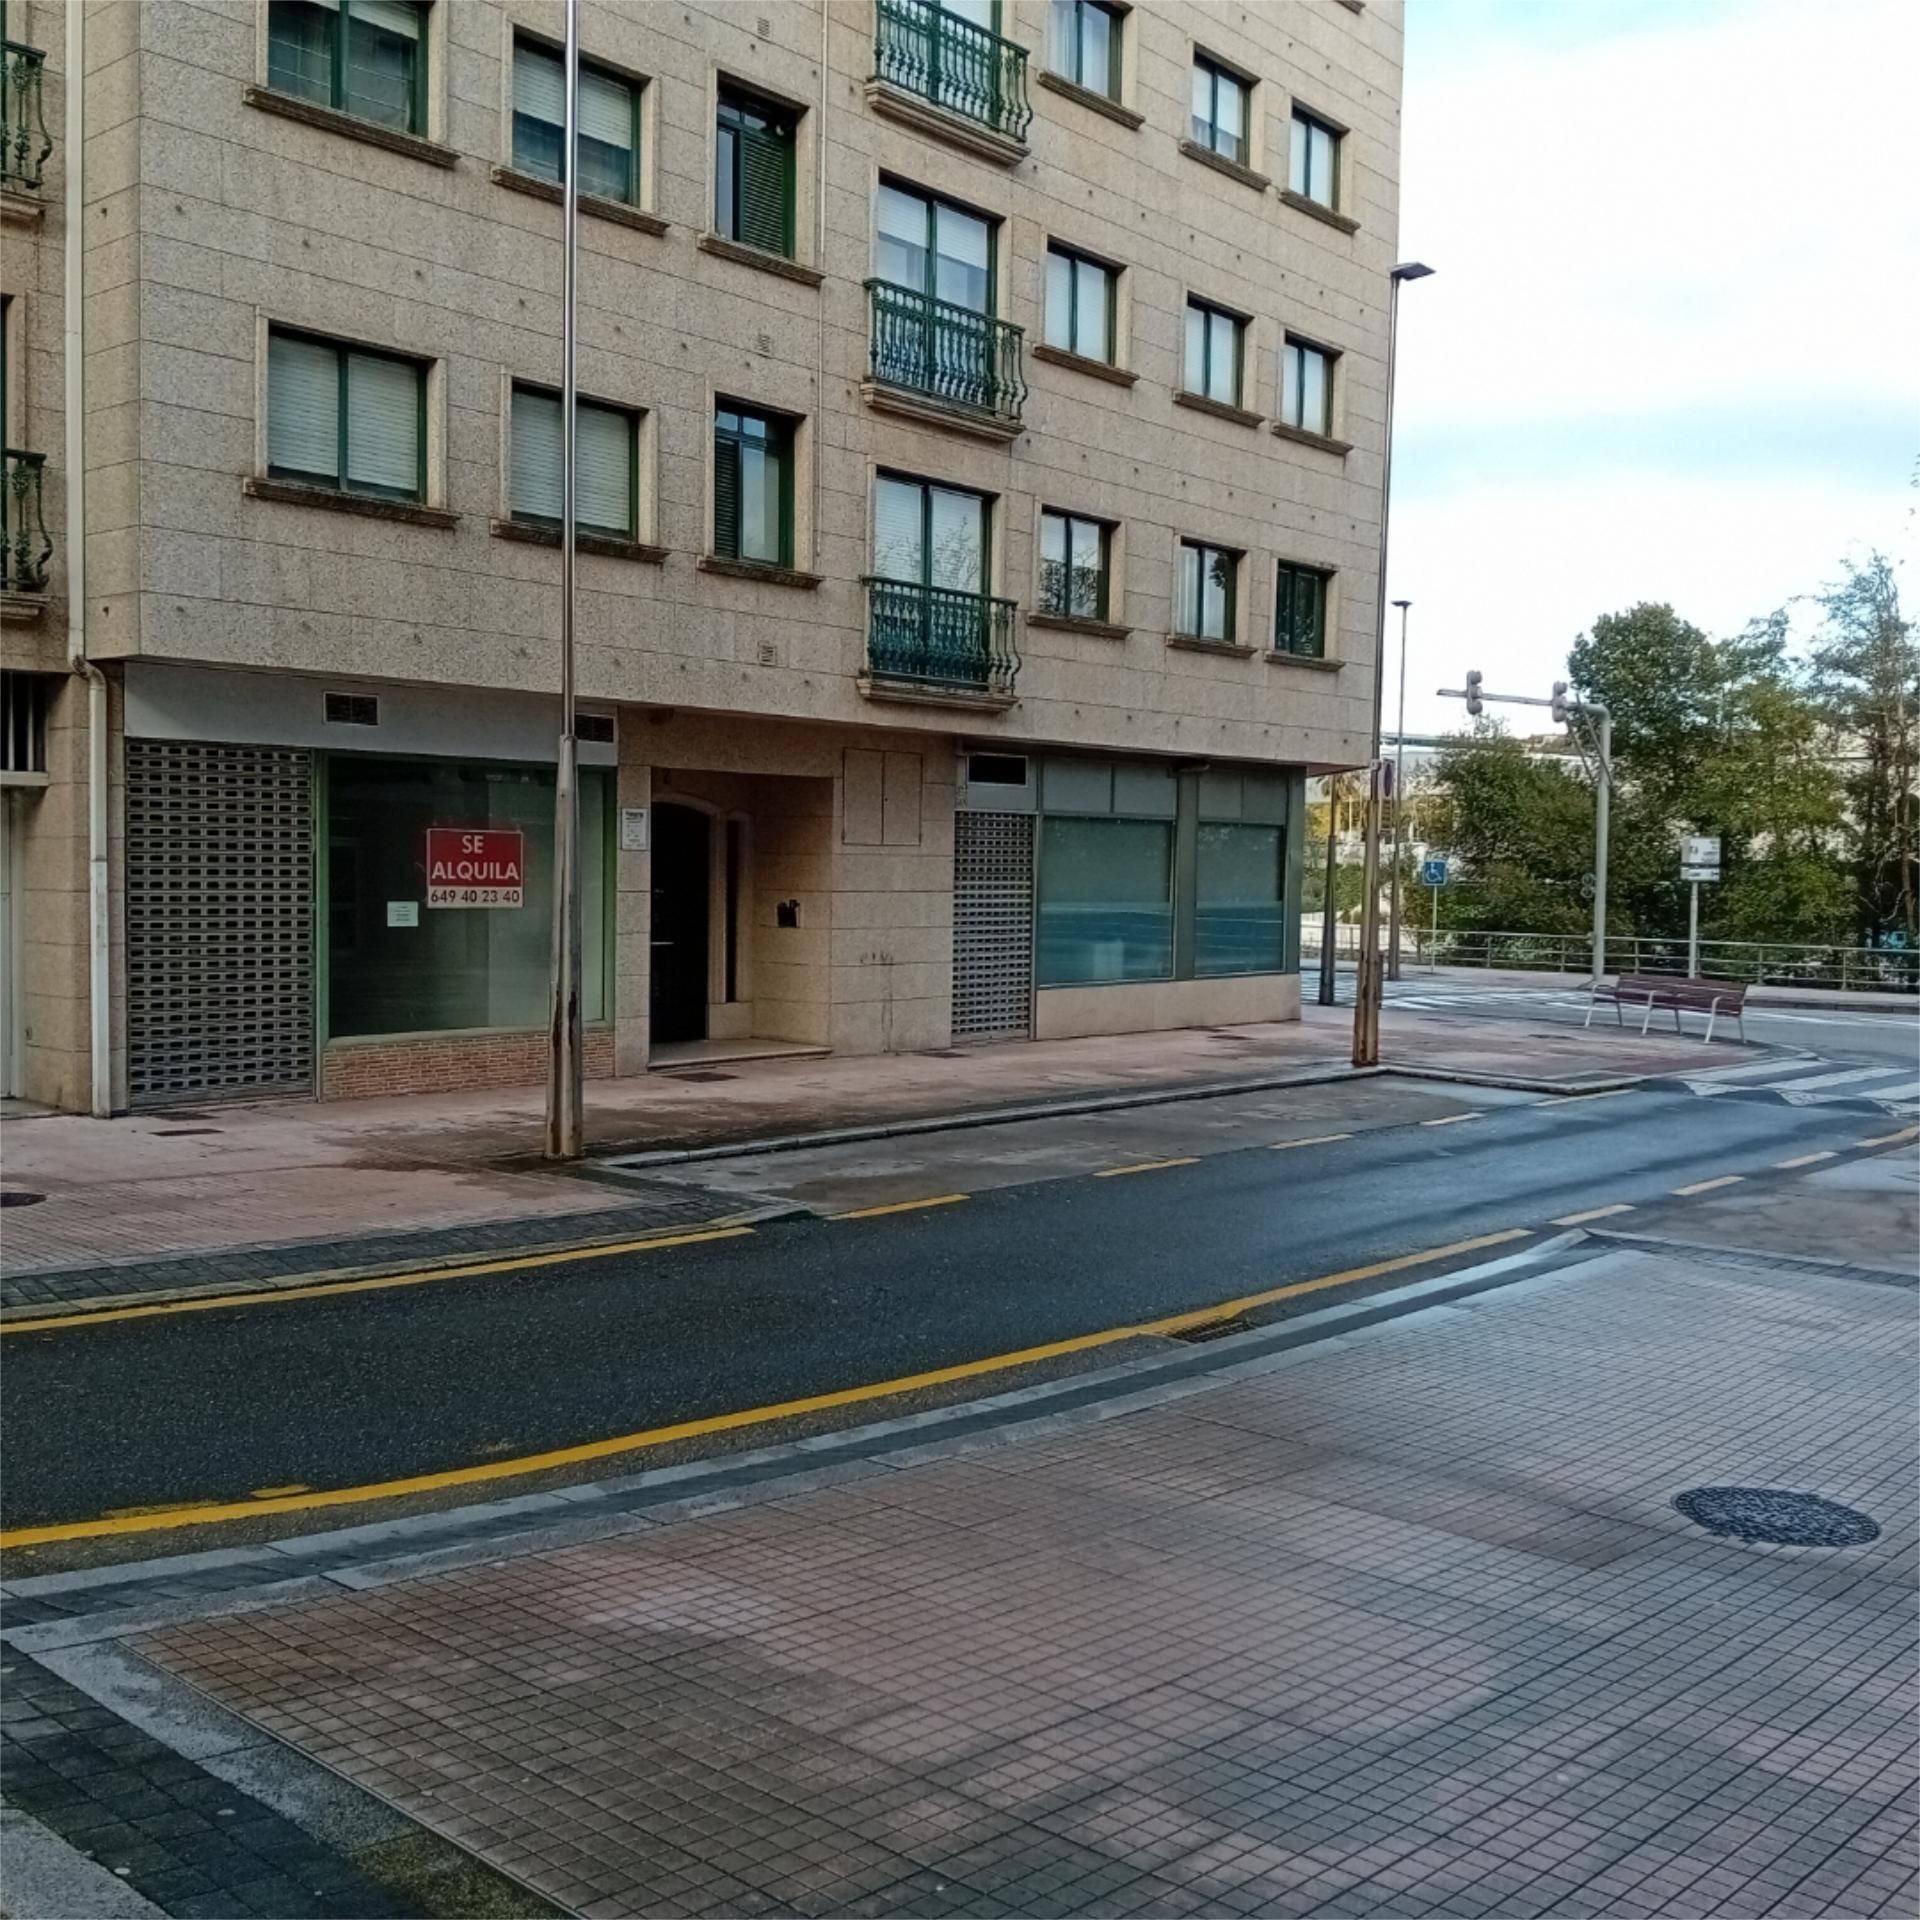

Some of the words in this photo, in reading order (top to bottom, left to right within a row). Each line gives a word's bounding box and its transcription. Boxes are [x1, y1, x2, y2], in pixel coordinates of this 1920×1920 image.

[462, 835, 484, 854] SE
[431, 861, 519, 881] ALQUILA
[431, 889, 456, 902] 649
[461, 889, 477, 902] 40
[481, 890, 498, 902] 23
[503, 890, 520, 902] 40
